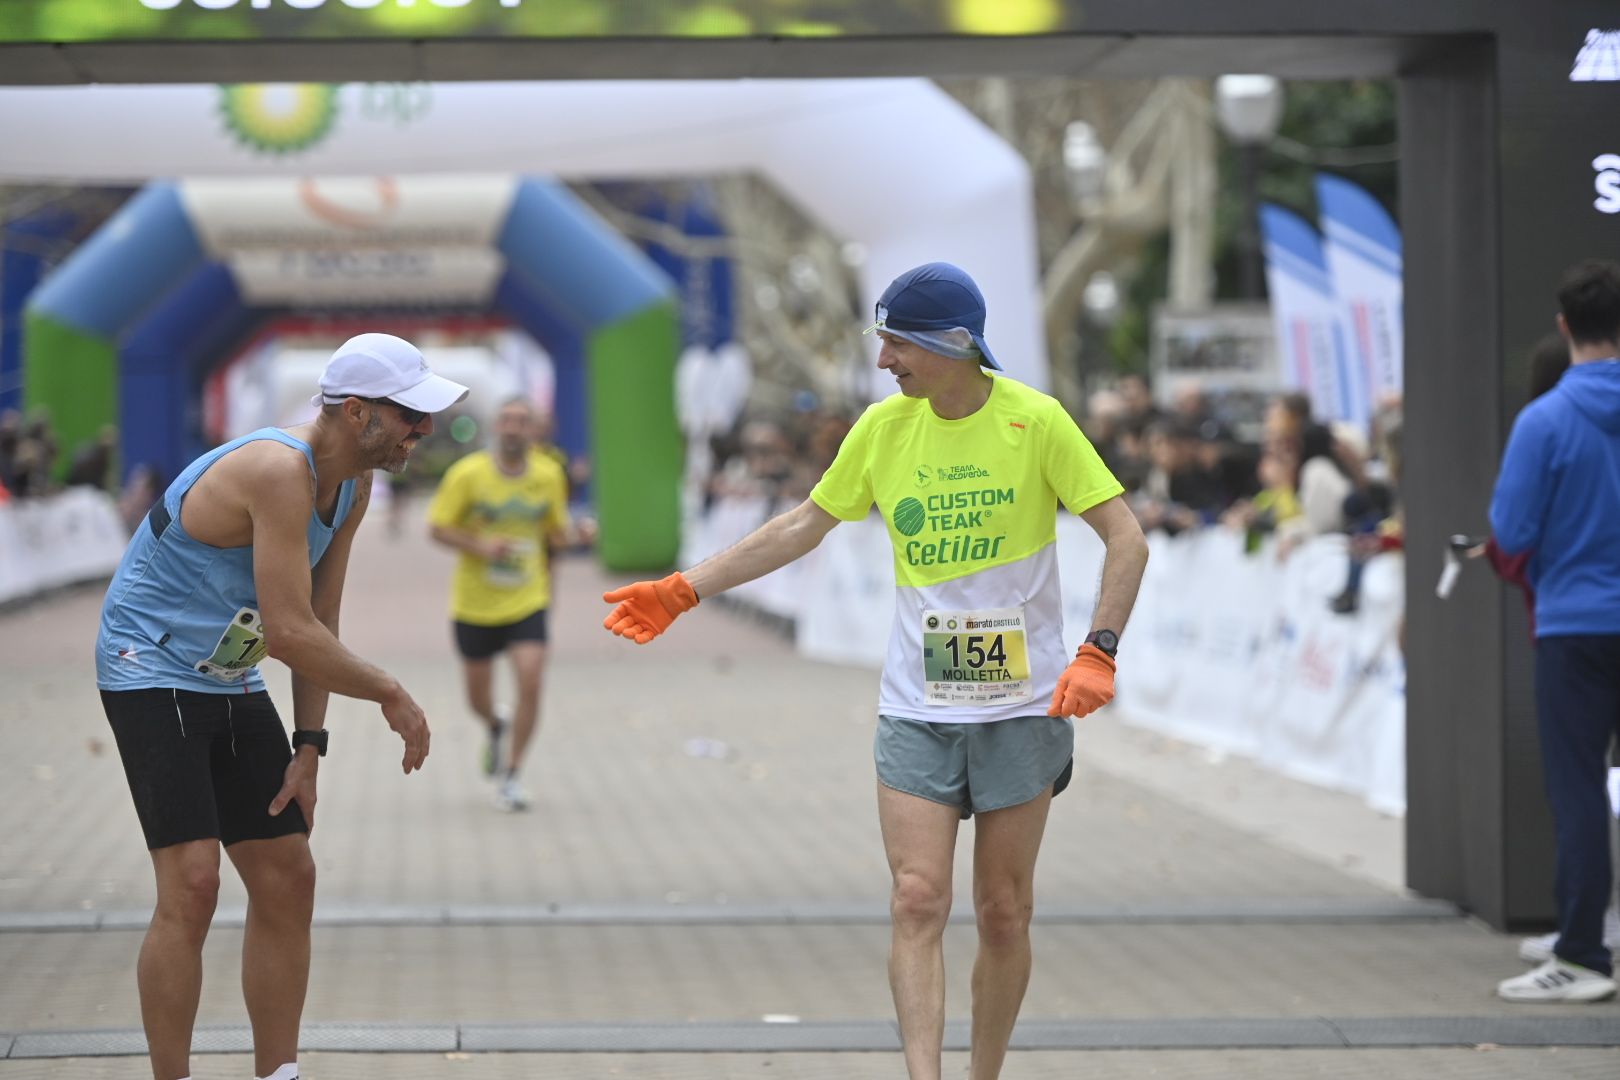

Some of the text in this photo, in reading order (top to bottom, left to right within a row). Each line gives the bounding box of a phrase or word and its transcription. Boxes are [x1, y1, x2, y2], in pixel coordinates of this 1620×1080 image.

[950, 464, 976, 473] TEAM
[927, 488, 1014, 512] CUSTOM
[906, 534, 1006, 566] Cetilar
[945, 634, 1007, 668] 154
[942, 669, 1012, 682] MOLLETTA
